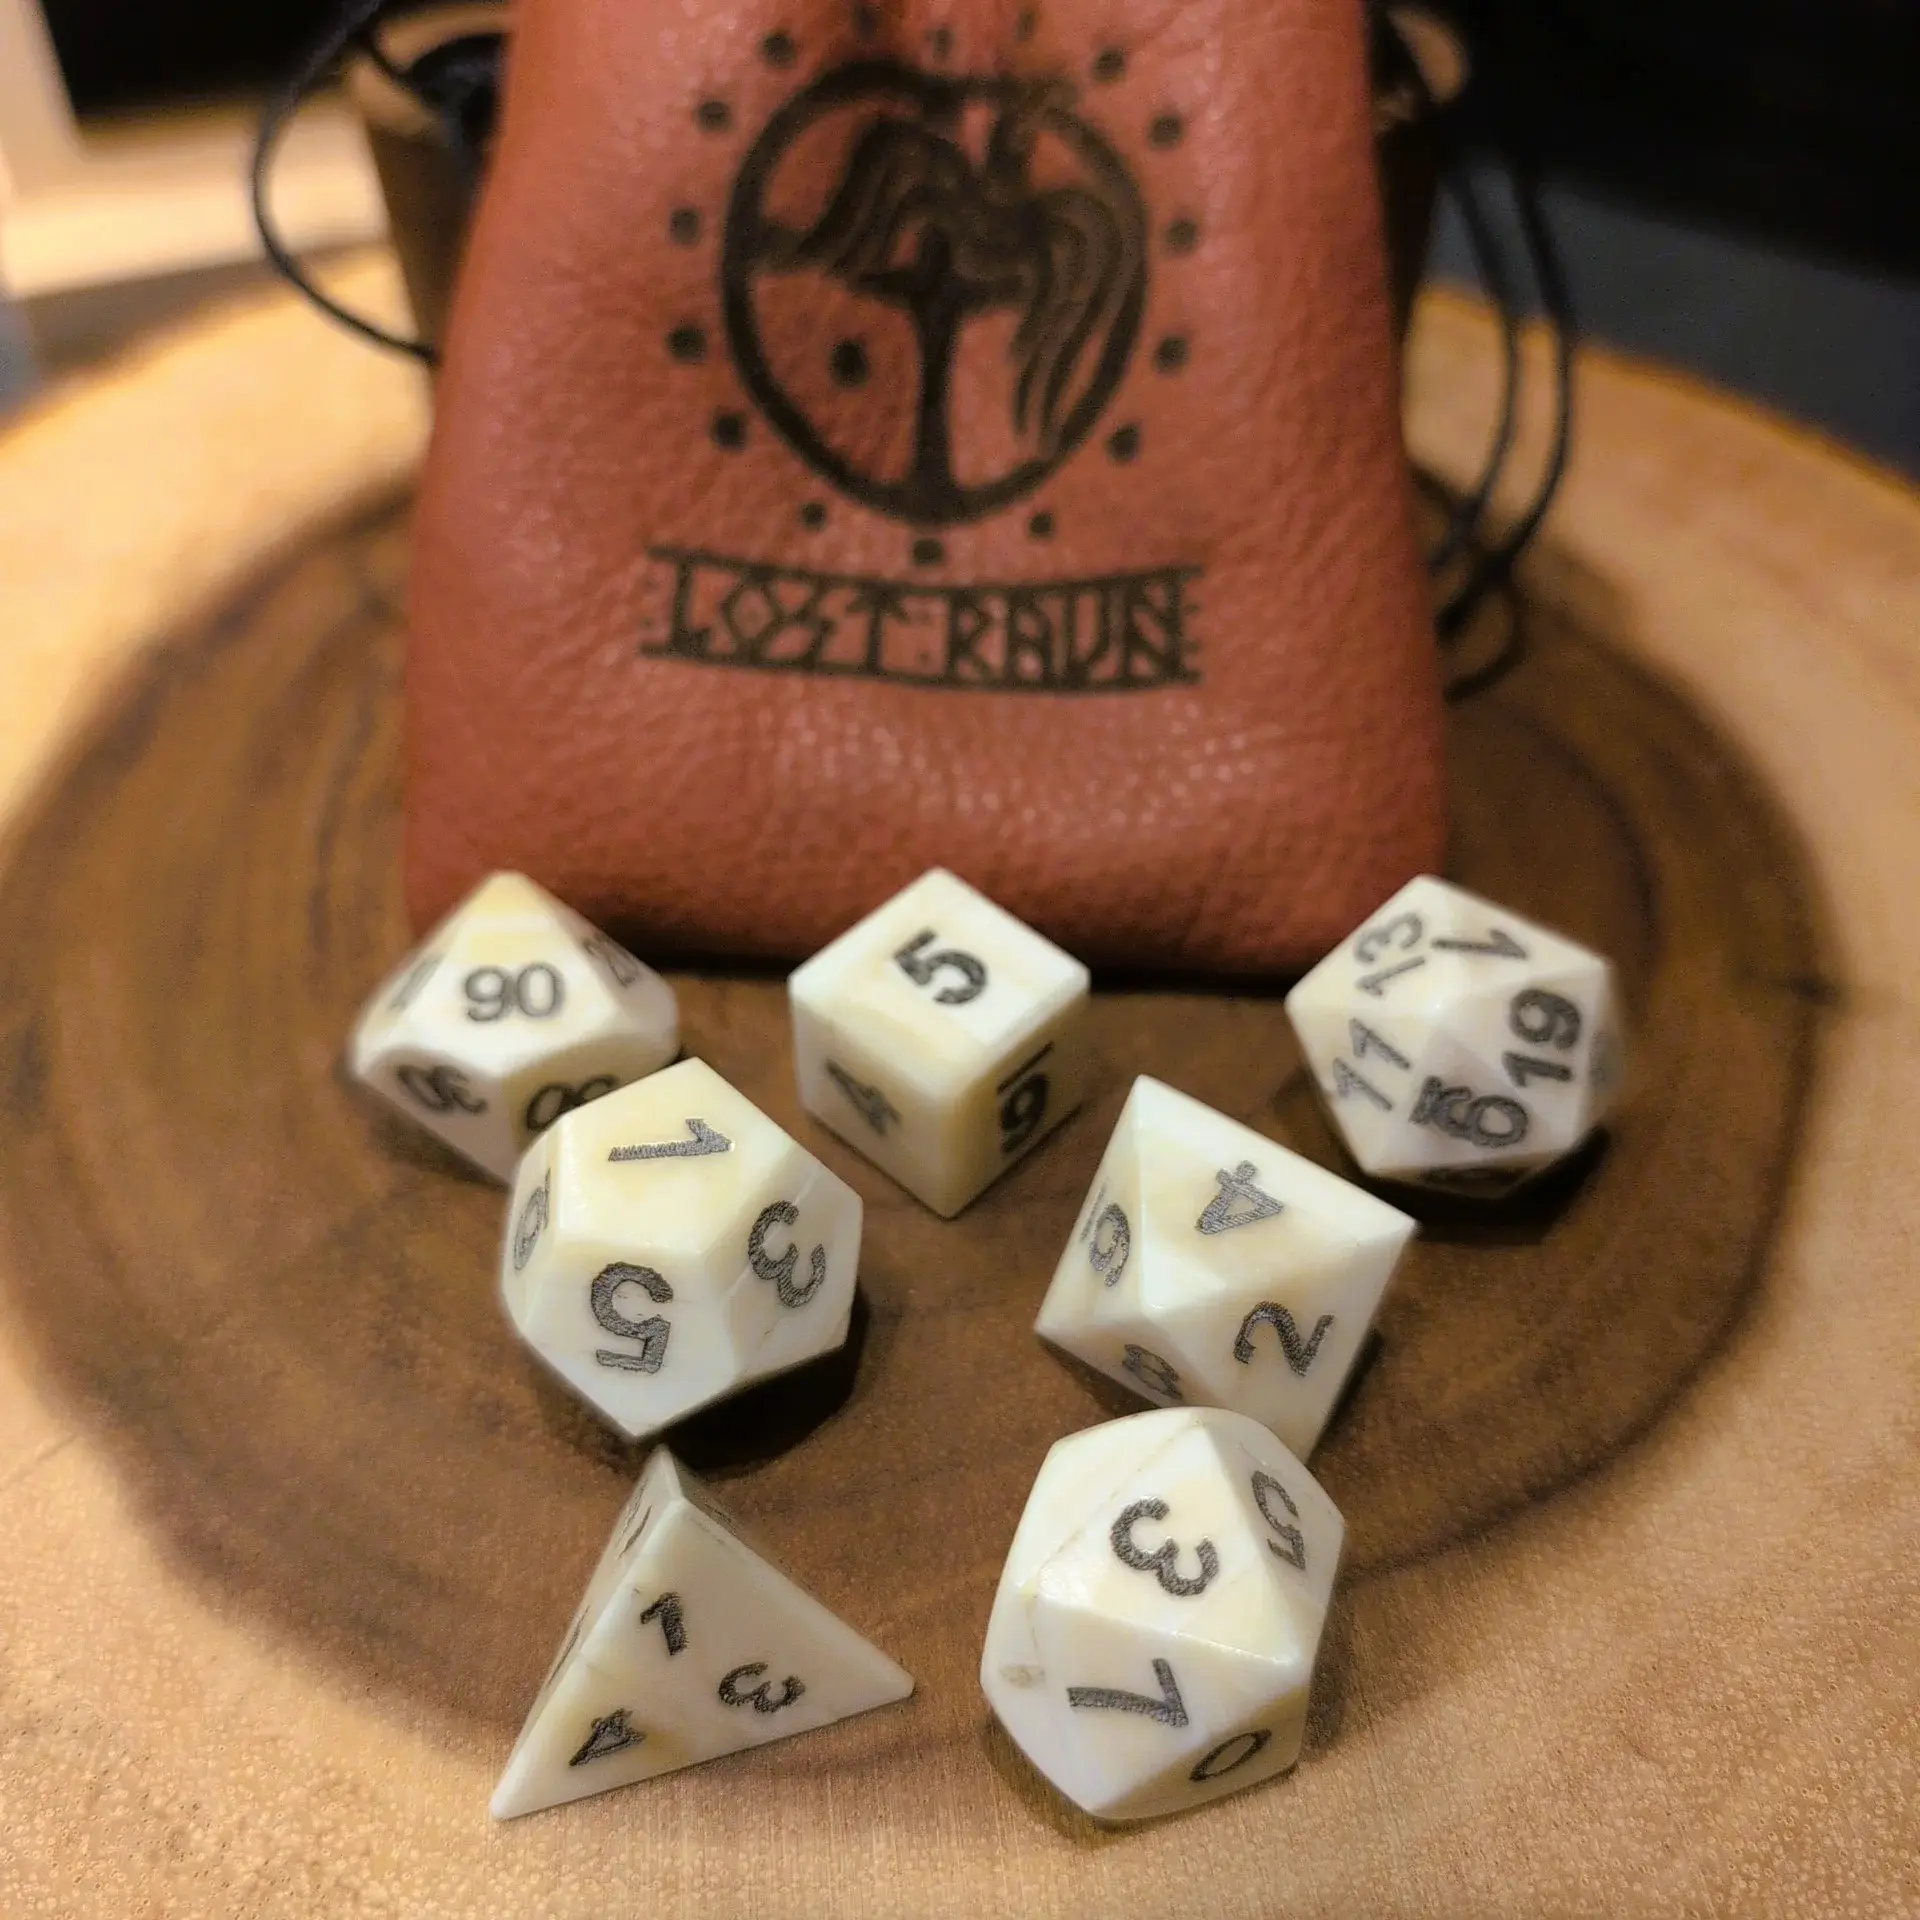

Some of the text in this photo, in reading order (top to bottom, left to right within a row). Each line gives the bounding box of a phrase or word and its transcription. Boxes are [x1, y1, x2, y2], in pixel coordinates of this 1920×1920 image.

[463, 961, 567, 1023] 90
[893, 927, 988, 1007] 5
[1353, 911, 1425, 996] 13
[1503, 988, 1582, 1088] 19
[825, 1056, 903, 1137] 4
[608, 1117, 733, 1163] 1
[1195, 1160, 1285, 1236] 4
[748, 1201, 827, 1308] 3
[591, 1261, 674, 1375] 5
[1233, 1301, 1336, 1378] 2
[1111, 1496, 1219, 1597] 3
[1251, 1470, 1306, 1571] 5
[640, 1590, 688, 1656] 1
[718, 1661, 806, 1714] 3
[1066, 1658, 1189, 1728] 7
[568, 1707, 647, 1768] 4
[1188, 1728, 1273, 1783] 0
